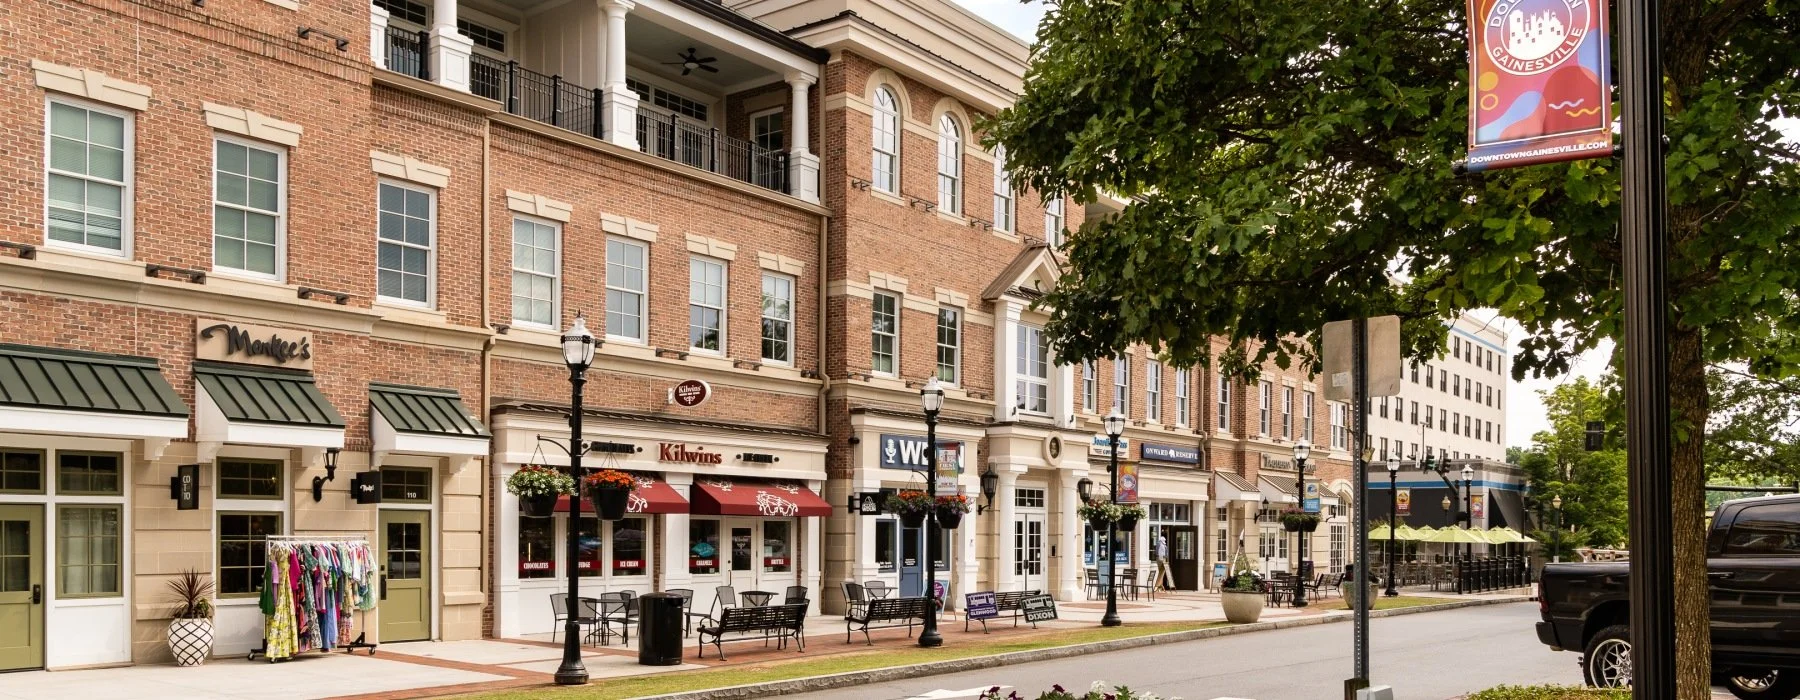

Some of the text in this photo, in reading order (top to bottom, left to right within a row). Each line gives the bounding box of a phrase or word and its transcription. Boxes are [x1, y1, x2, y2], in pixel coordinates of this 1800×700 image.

[1492, 27, 1583, 71] GAINESVILLE
[1471, 141, 1608, 164] DOWNTOWNGAINESVILLE.COM
[201, 324, 311, 363] Monkee's
[659, 443, 722, 464] Kilwins
[1145, 447, 1199, 460] ONWARD RESERVE
[1027, 611, 1055, 621] DIXON
